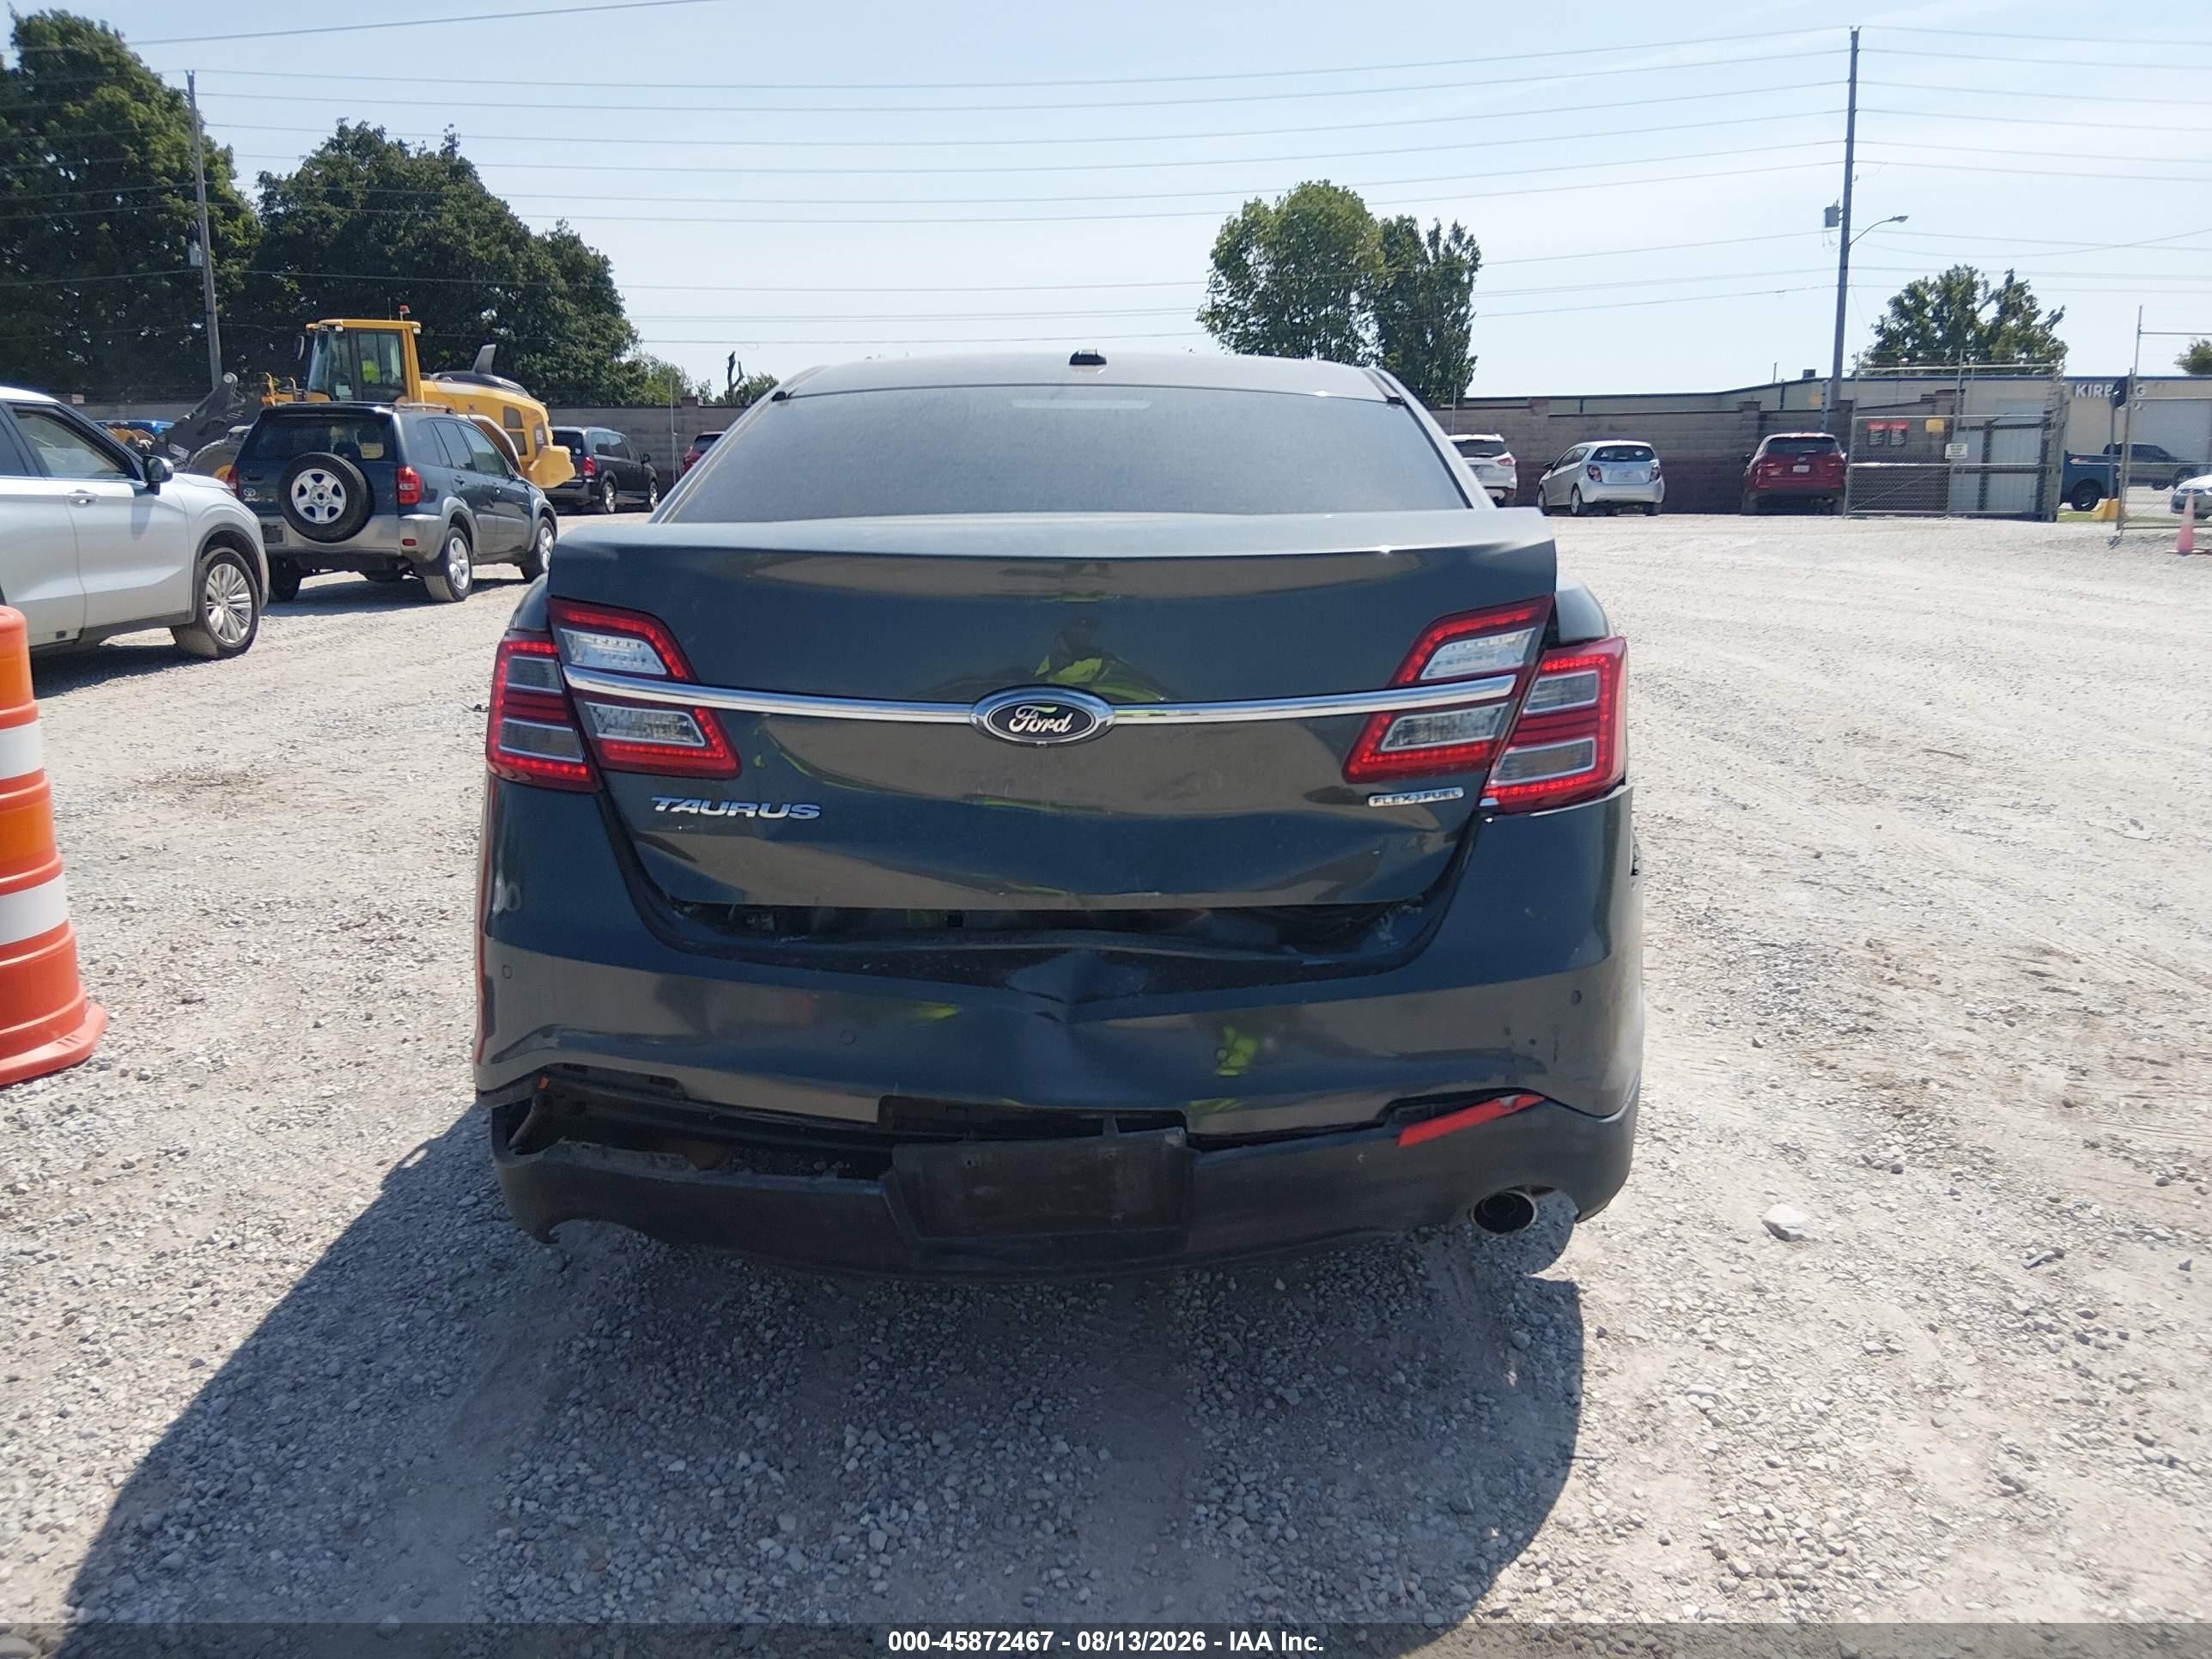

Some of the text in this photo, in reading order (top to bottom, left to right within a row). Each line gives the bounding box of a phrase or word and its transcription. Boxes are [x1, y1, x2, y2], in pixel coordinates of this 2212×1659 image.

[1009, 705, 1073, 733] Ford
[651, 796, 822, 820] TAURUS
[1373, 788, 1460, 805] FLEX FUEL
